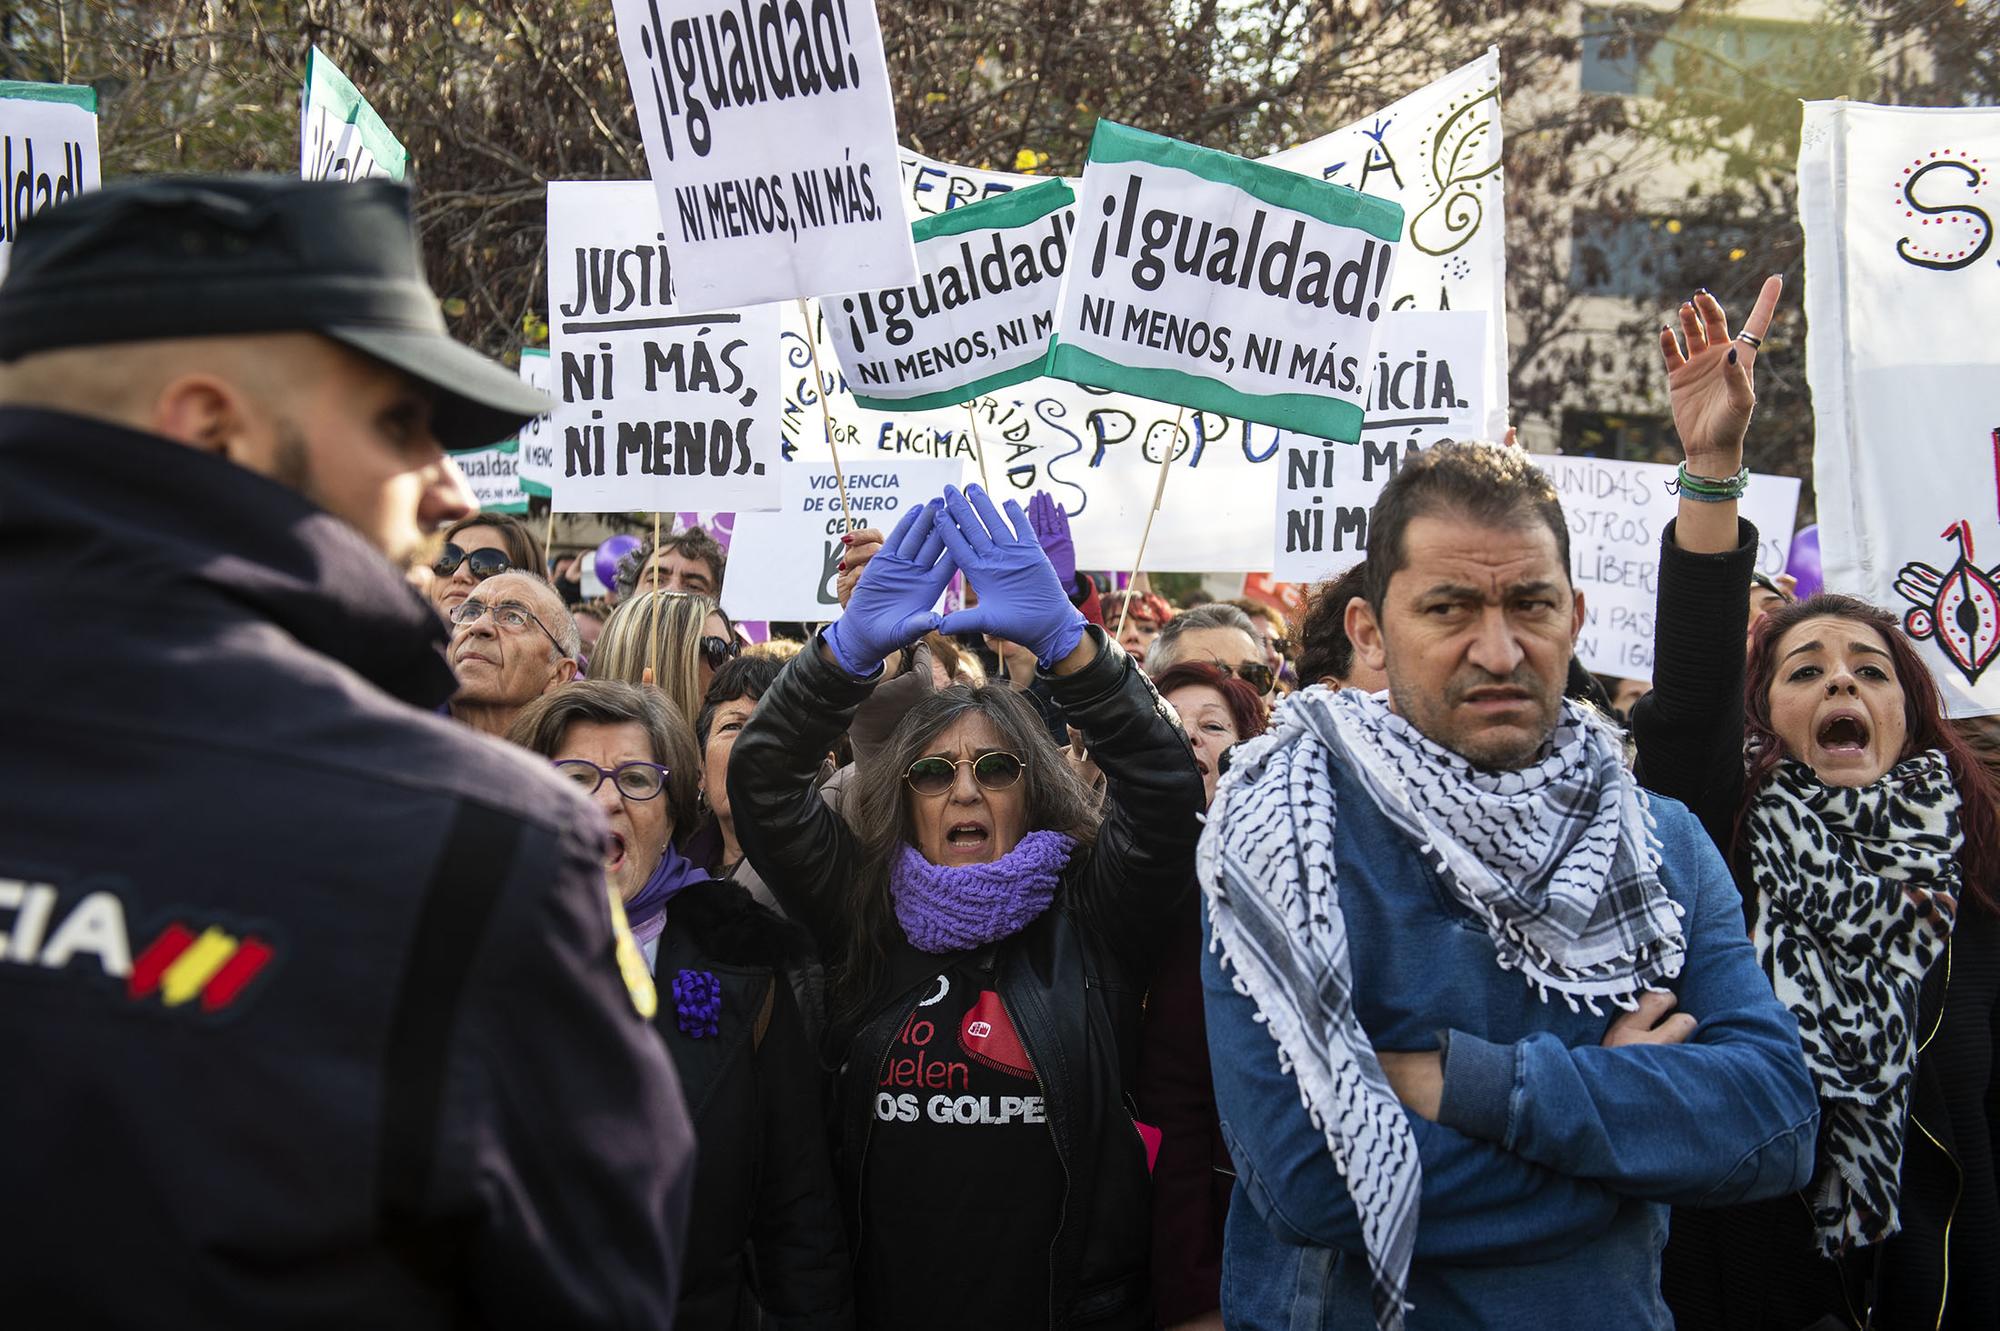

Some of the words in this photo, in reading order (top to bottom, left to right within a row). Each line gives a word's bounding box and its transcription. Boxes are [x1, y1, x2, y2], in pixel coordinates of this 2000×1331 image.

[641, 0, 859, 162] ¡Igualdad!
[675, 185, 706, 243] NI
[703, 175, 798, 243] MENOS,
[791, 170, 826, 229] NI
[823, 147, 882, 225] MÁS.
[1091, 174, 1392, 322] ¡Igualdad!
[643, 326, 758, 408] MÁS,
[857, 361, 891, 385] NI
[894, 330, 997, 383] MENOS,
[996, 317, 1028, 351] NI
[1079, 293, 1115, 337] NI
[1121, 304, 1235, 373] MENOS,
[1242, 333, 1283, 375] NI
[1288, 342, 1363, 395] MÁS.
[615, 417, 766, 477] MENOS.
[809, 474, 900, 490] VIOLENCIA
[803, 497, 824, 512] DE
[828, 493, 899, 512] GÉNERO
